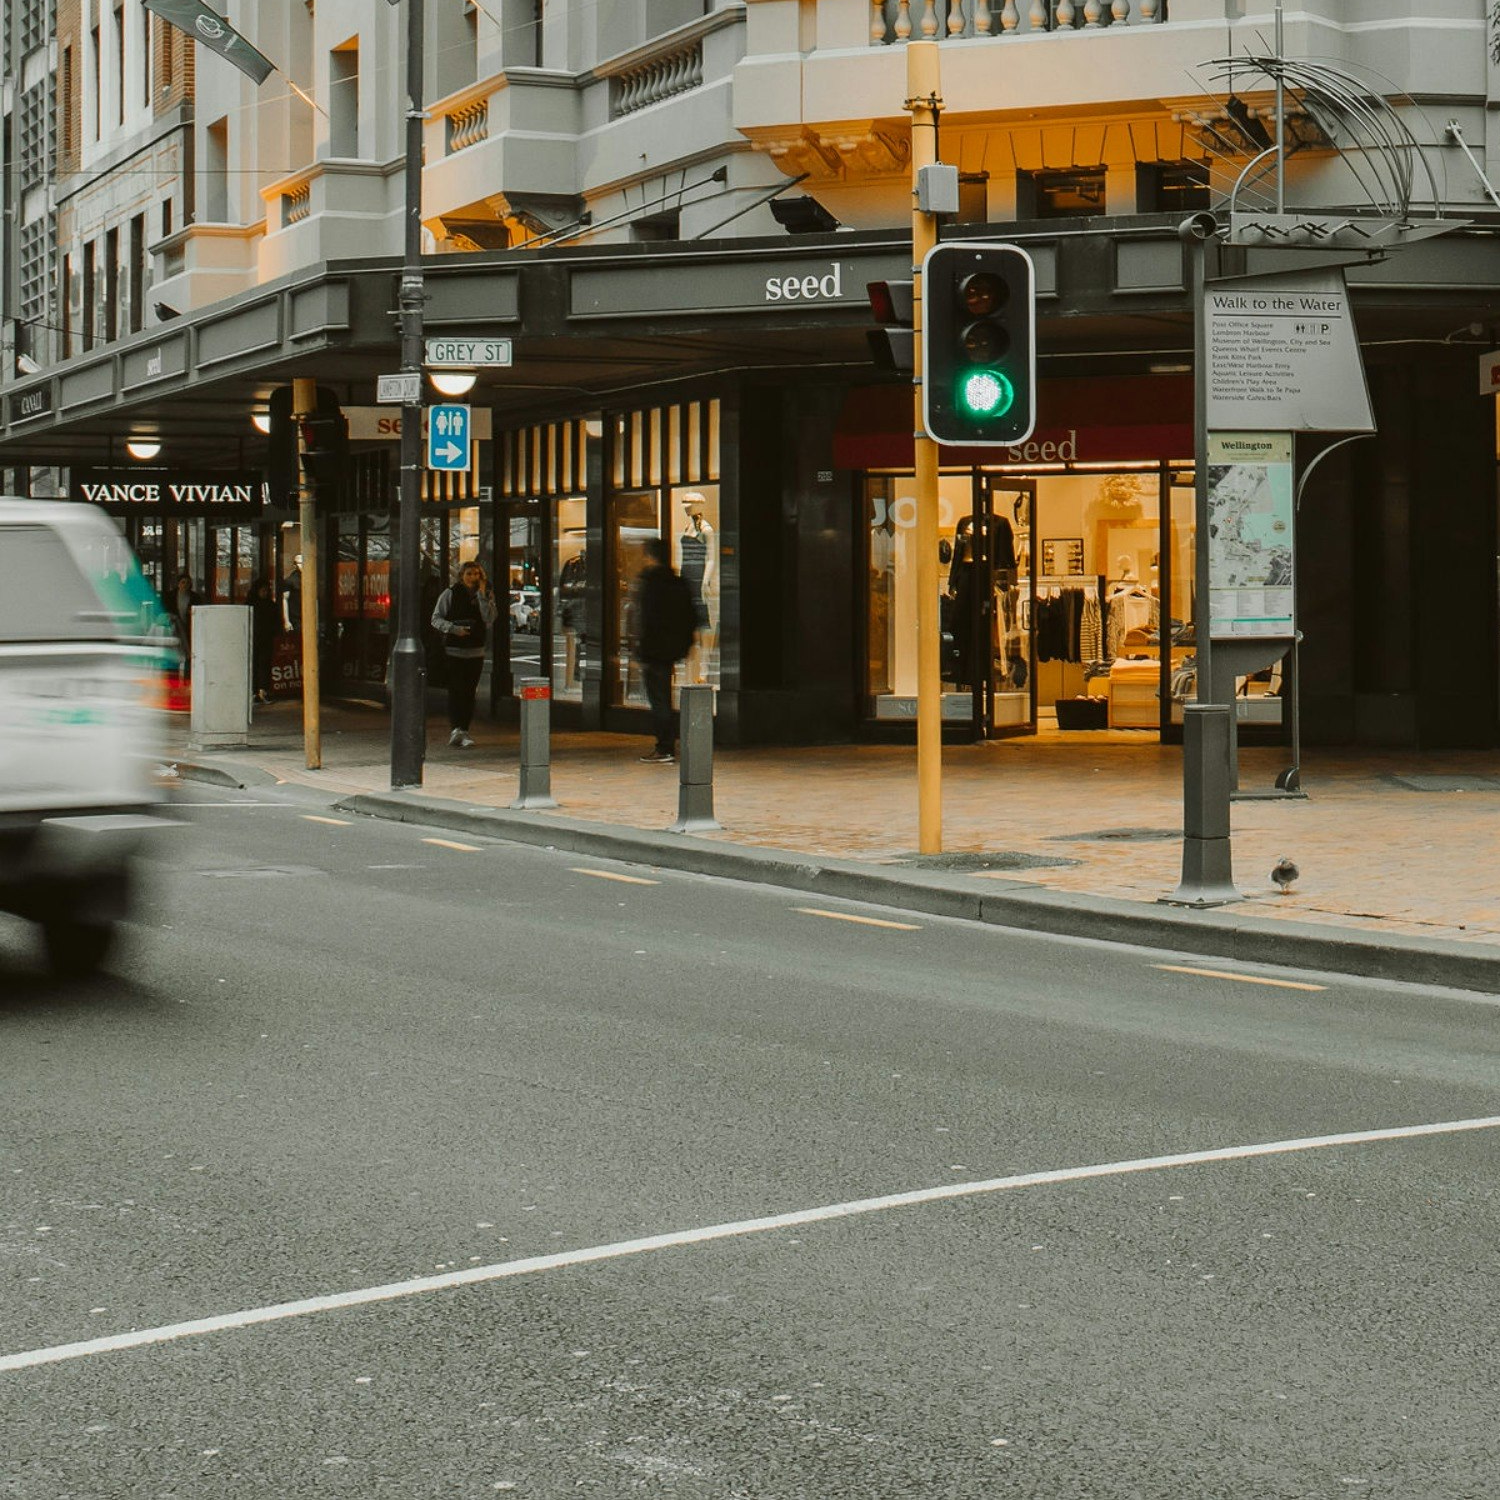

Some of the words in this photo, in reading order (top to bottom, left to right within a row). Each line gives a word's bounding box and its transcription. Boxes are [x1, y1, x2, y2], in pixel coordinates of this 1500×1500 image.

[766, 262, 843, 300] seed
[1213, 297, 1247, 309] Walk
[1252, 300, 1267, 310] to
[1272, 299, 1294, 310] the
[1300, 299, 1341, 311] Water
[435, 344, 475, 361] GREY
[485, 344, 502, 361] ST
[1008, 430, 1078, 462] seed
[1221, 441, 1272, 451] Wellington
[81, 484, 160, 502] VANCE
[169, 485, 253, 502] VIVIAN
[271, 660, 300, 681] sal
